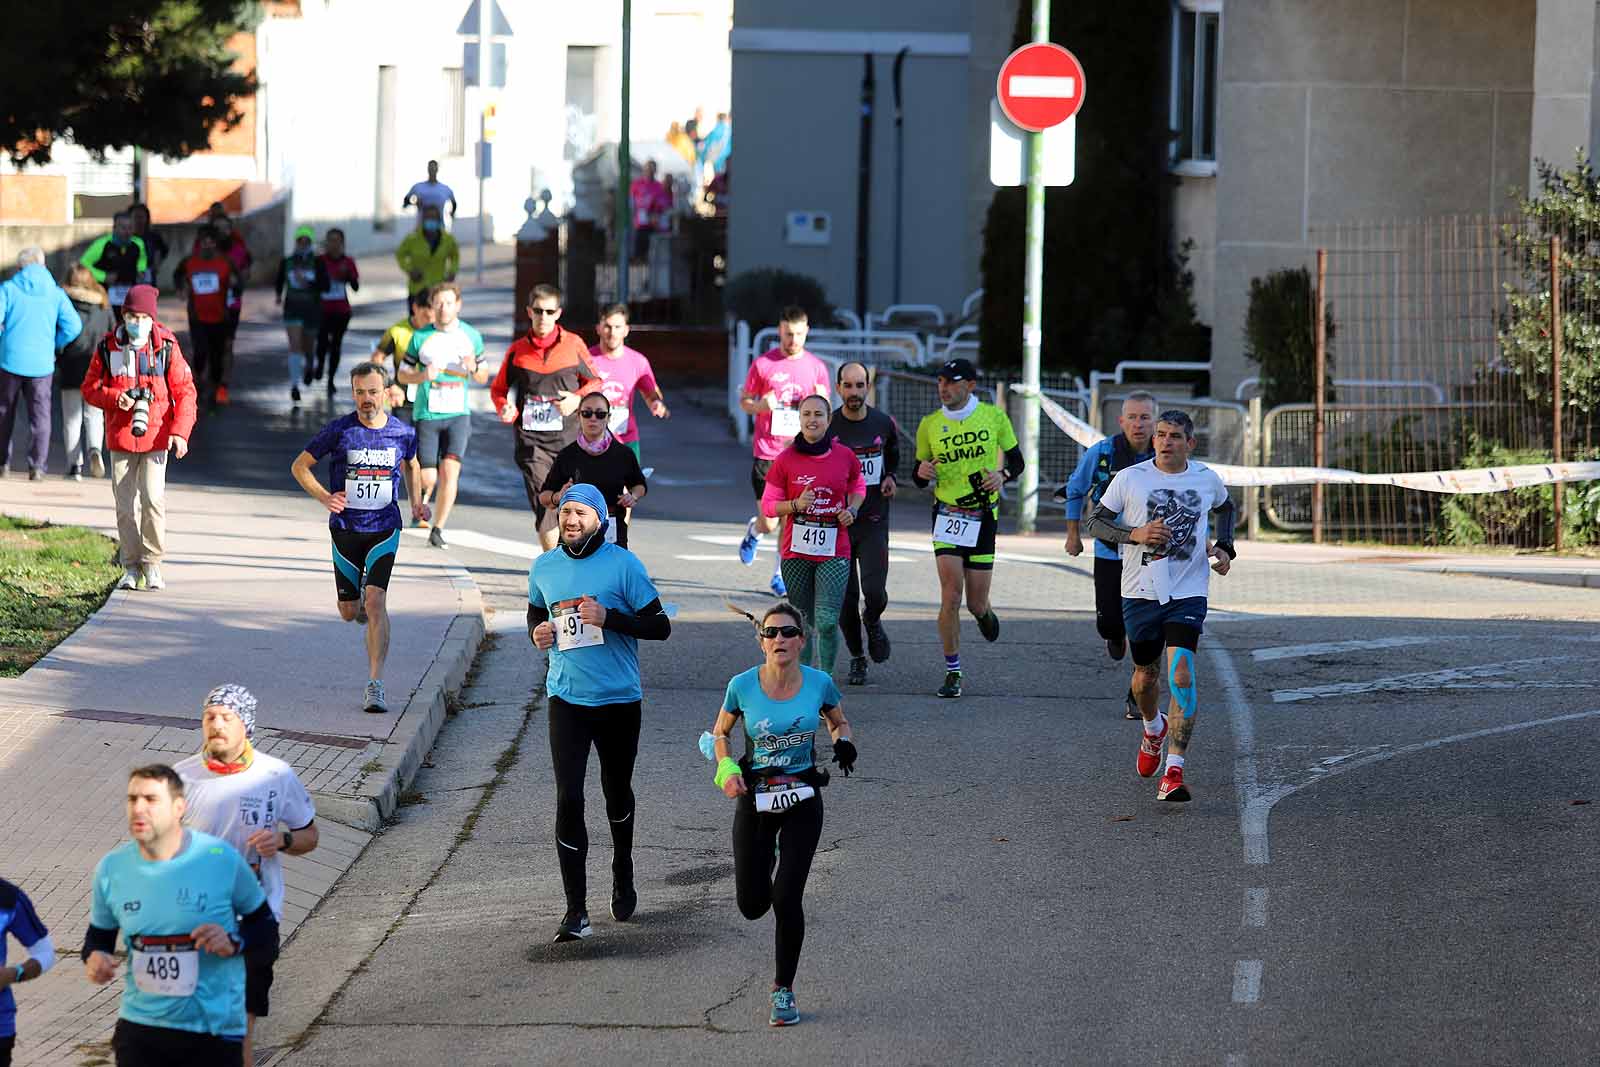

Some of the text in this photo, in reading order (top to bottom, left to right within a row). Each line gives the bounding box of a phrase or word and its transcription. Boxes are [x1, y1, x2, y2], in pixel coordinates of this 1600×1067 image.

[939, 430, 990, 450] TODO
[938, 445, 986, 464] SUMA
[356, 483, 381, 500] 517
[802, 528, 826, 547] 419
[945, 519, 969, 537] 297
[772, 792, 801, 810] 409
[146, 956, 180, 981] 489
